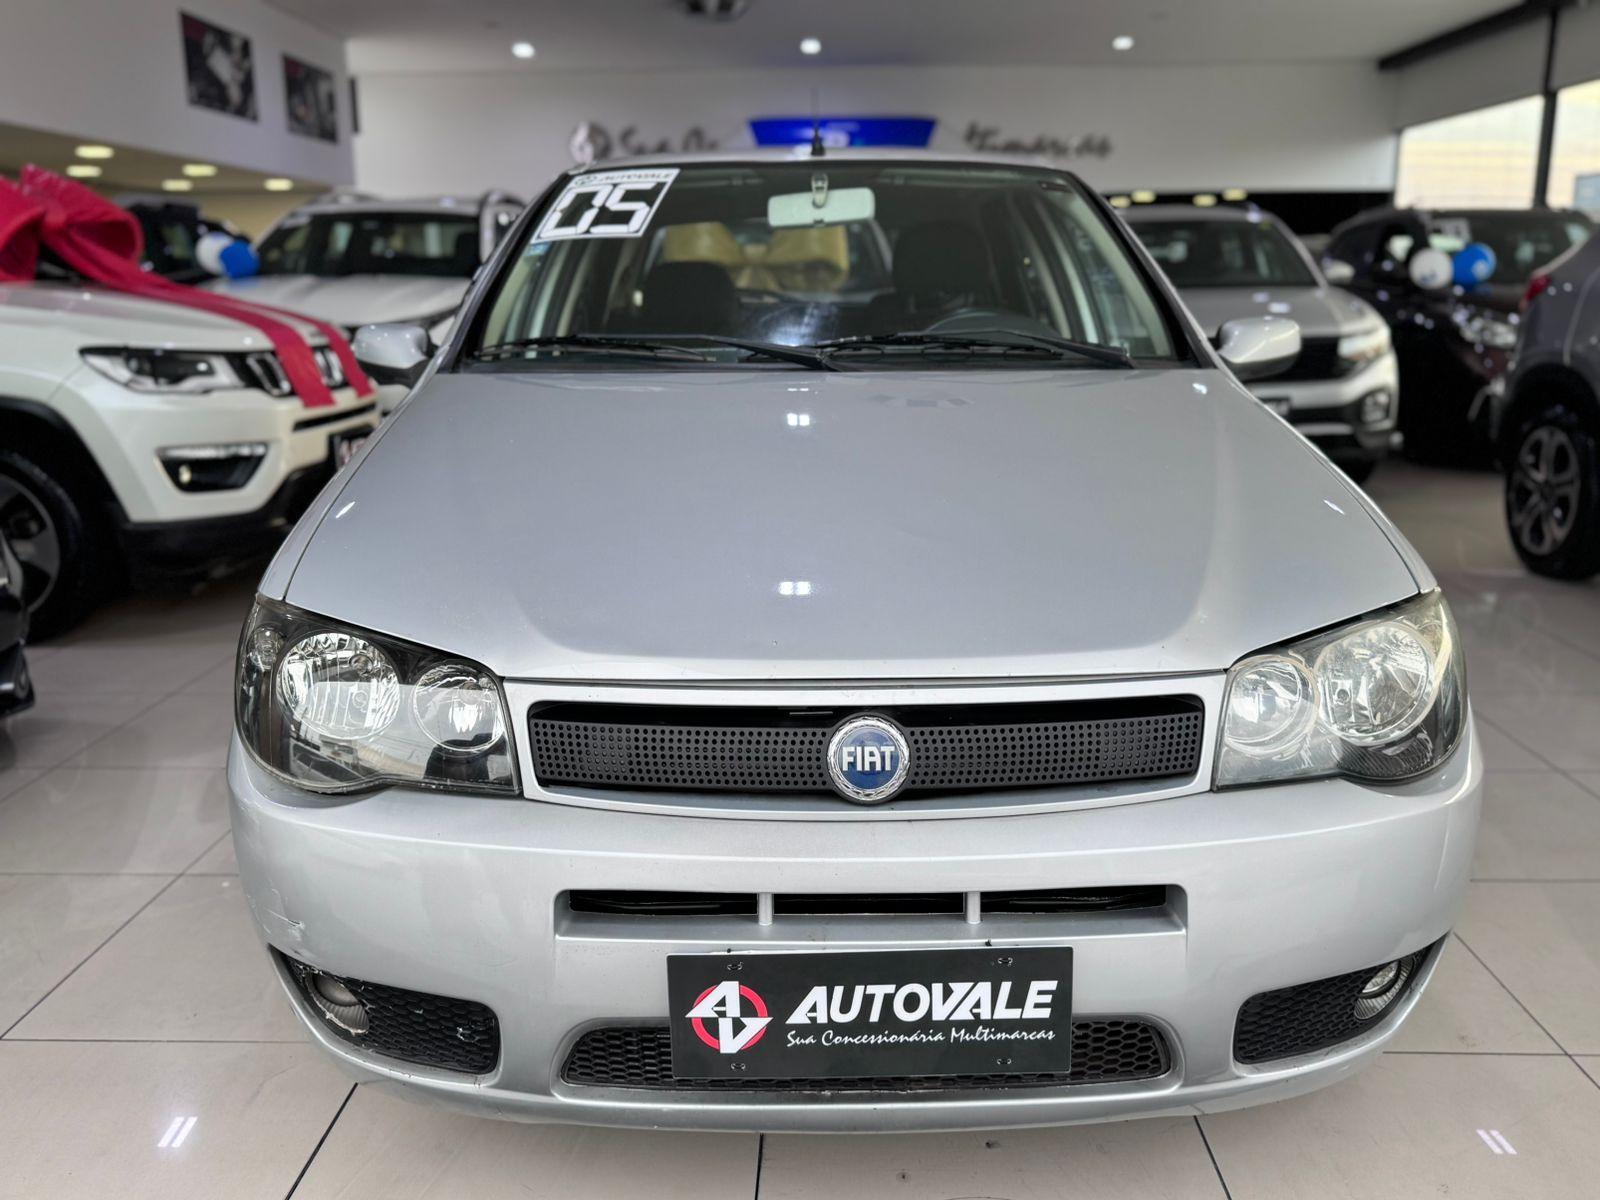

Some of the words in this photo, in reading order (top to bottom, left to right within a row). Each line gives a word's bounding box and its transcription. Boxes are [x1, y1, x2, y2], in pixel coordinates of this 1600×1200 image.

[539, 182, 657, 238] 05
[842, 745, 895, 772] FIAT
[785, 980, 1058, 1025] AUTOVALE
[787, 1030, 816, 1047] Sua
[821, 1028, 946, 1047] Concessionária
[950, 1025, 1056, 1044] Multimarcas
